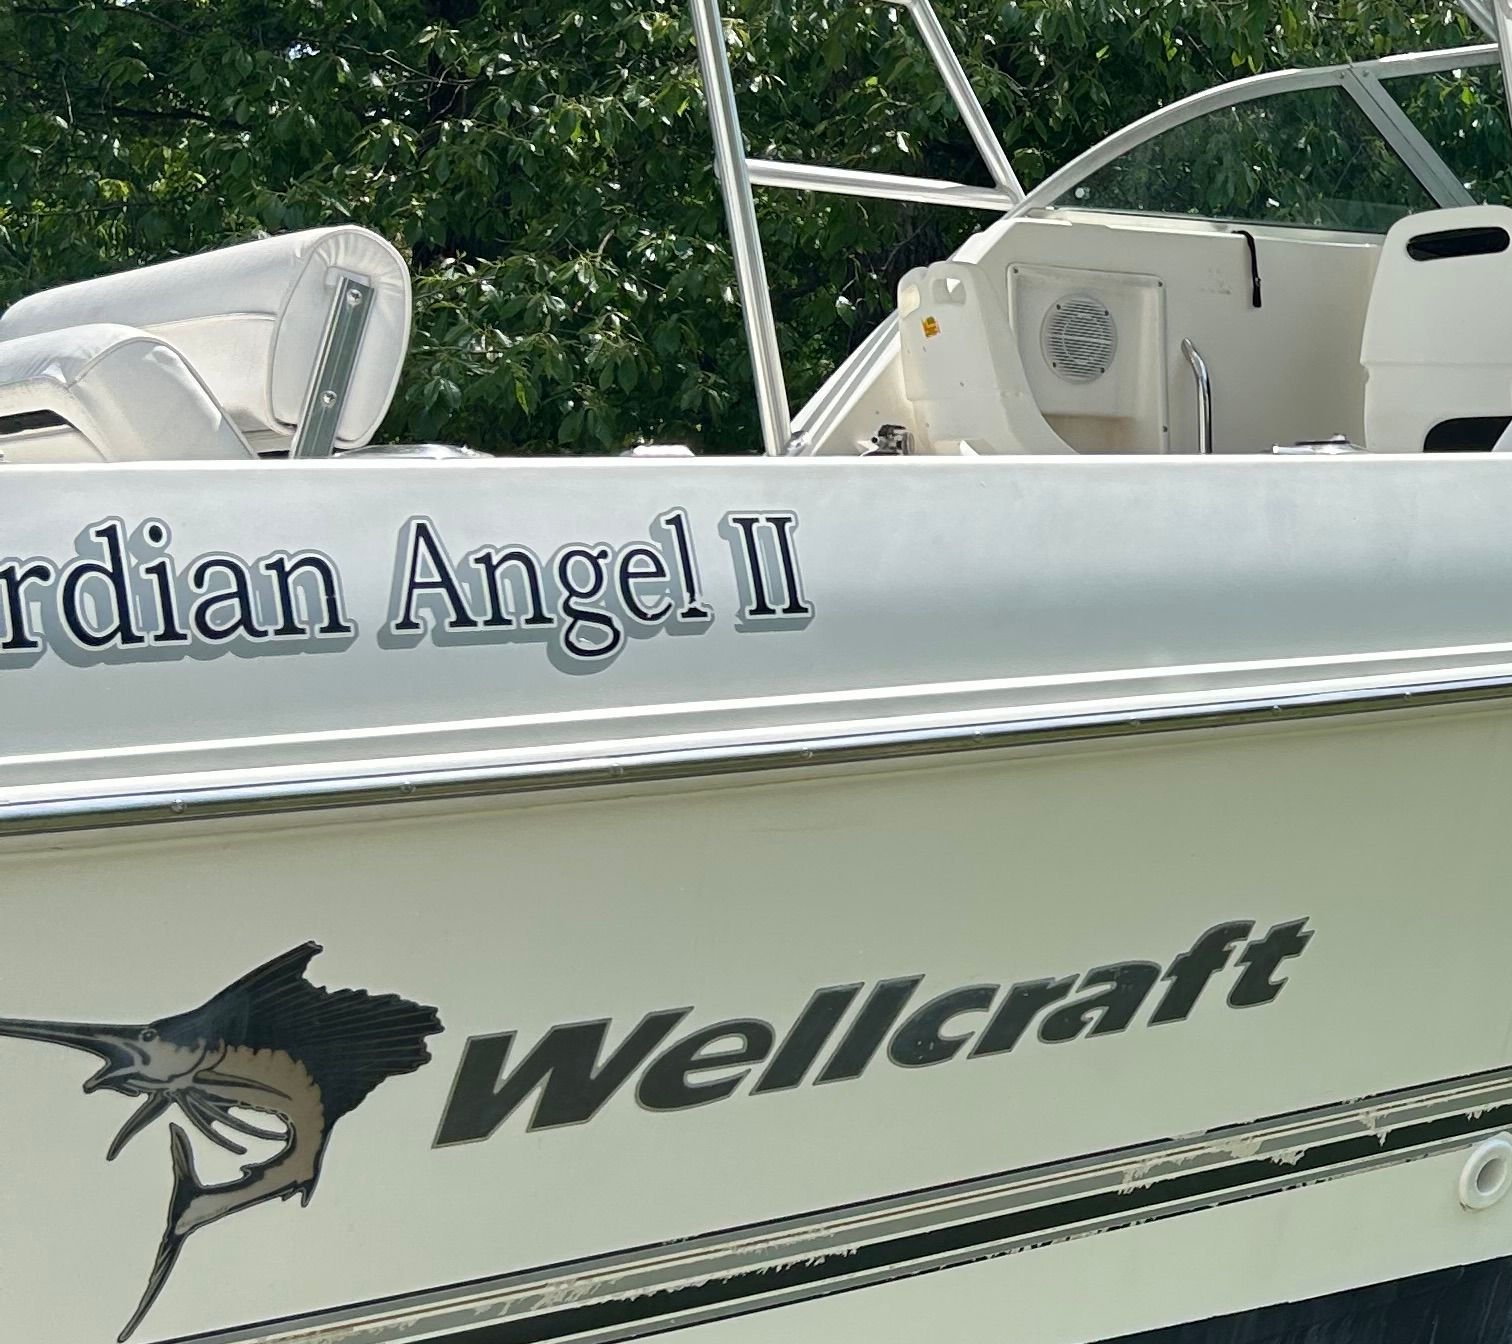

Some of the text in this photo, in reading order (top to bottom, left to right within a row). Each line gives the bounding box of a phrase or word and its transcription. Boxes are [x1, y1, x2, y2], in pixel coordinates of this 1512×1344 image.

[0, 509, 812, 657] rdian Angel II
[432, 917, 1312, 1149] Wellcraft
